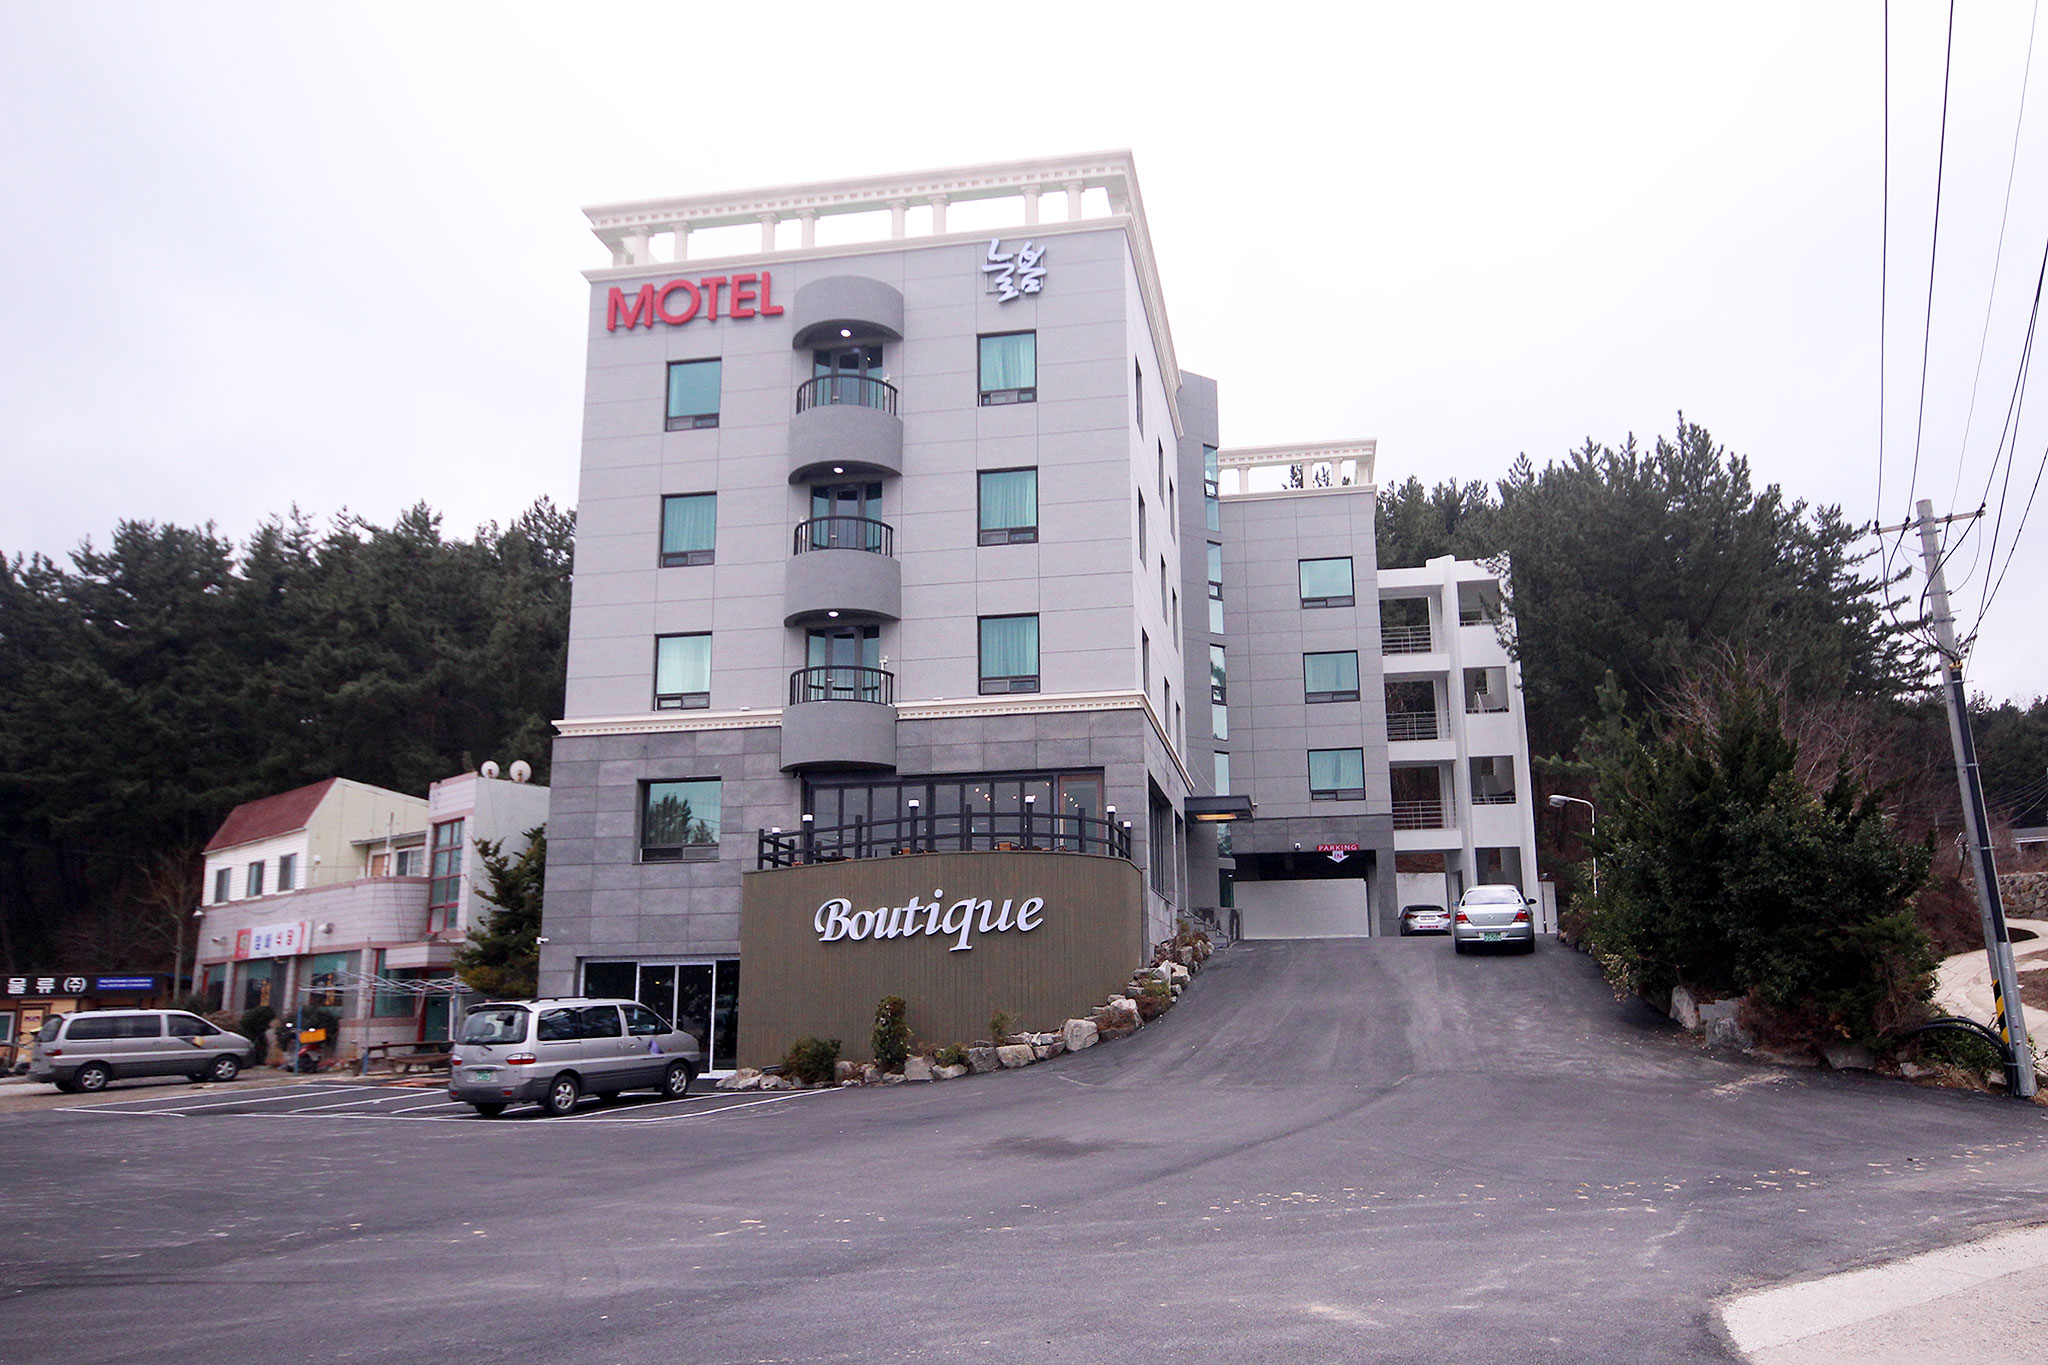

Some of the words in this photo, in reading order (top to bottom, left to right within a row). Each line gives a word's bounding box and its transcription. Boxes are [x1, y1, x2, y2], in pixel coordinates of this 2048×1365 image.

[606, 271, 784, 332] MOTEL
[1318, 843, 1358, 851] PARKING
[814, 888, 1045, 952] Boutique
